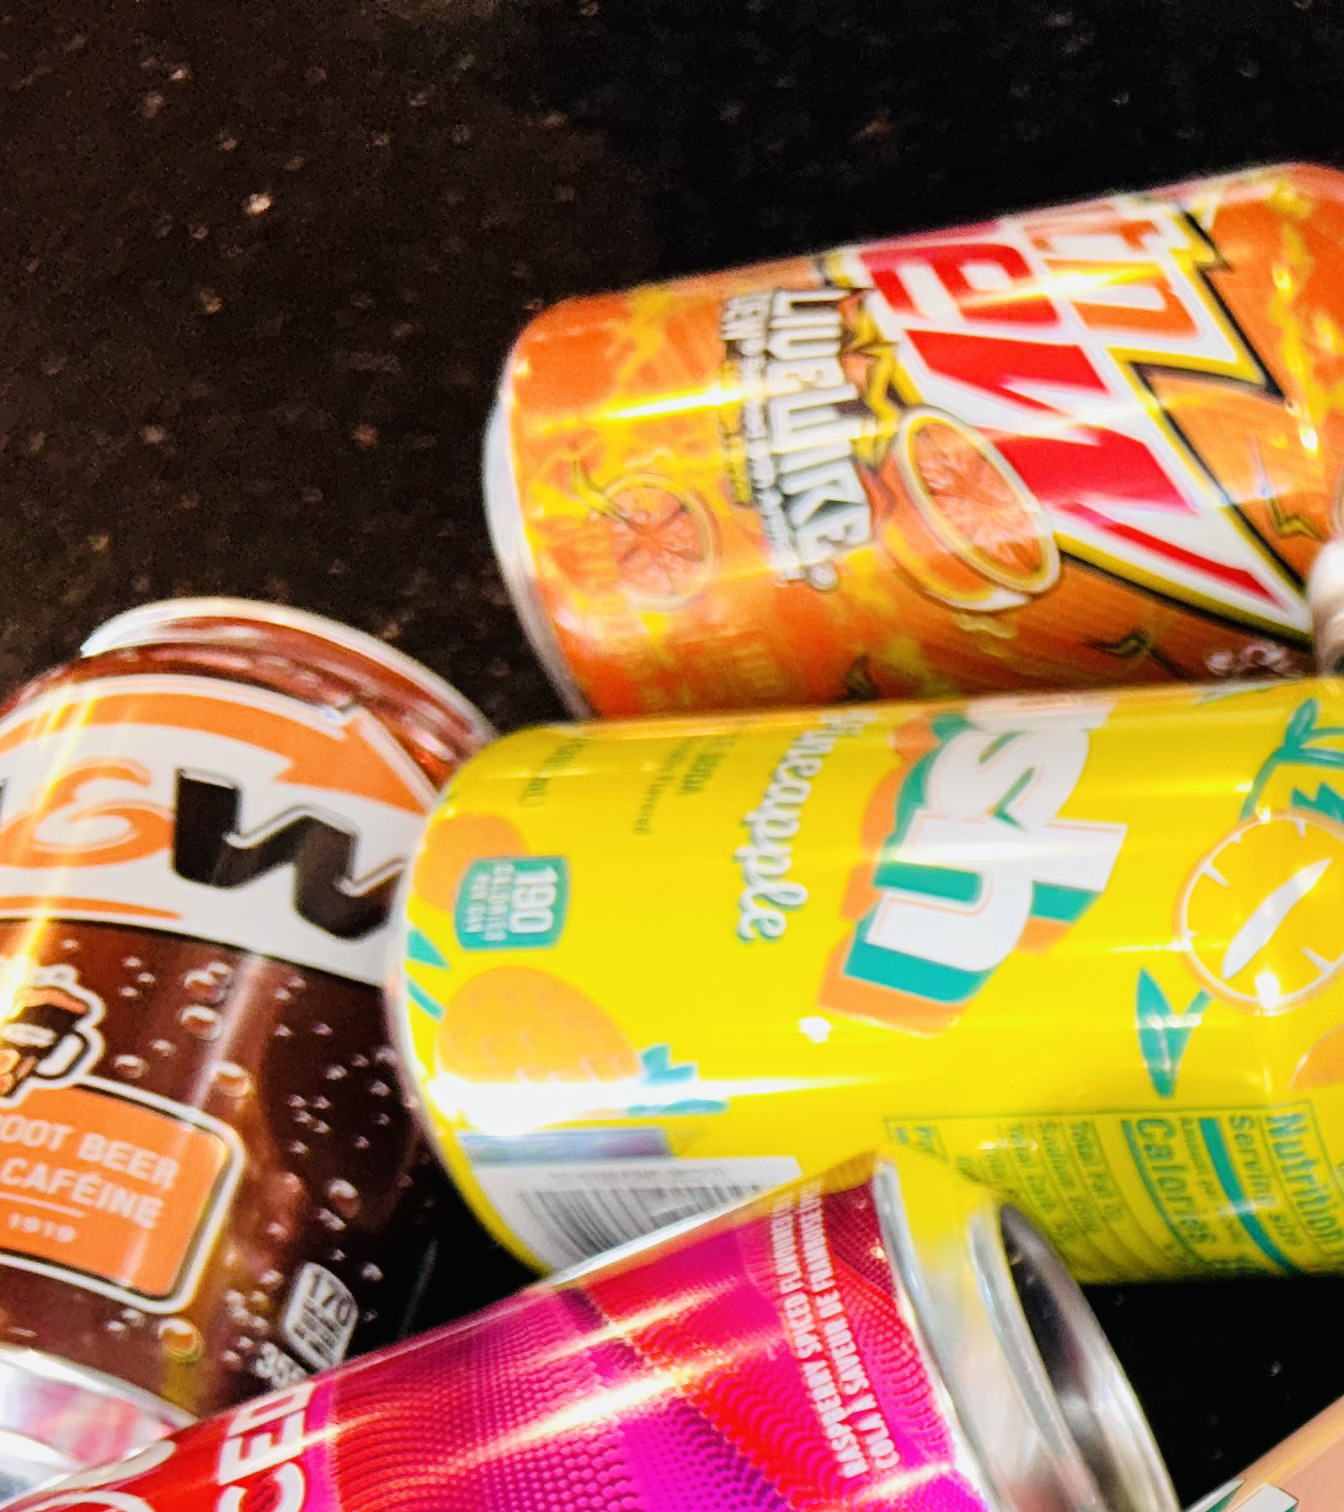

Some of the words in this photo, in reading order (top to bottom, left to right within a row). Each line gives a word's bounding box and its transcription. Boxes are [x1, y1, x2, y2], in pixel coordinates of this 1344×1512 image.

[508, 865, 559, 936] 190
[0, 1114, 76, 1152] OOT
[78, 1132, 178, 1192] BEER
[784, 1292, 823, 1360] SPICED
[815, 1287, 845, 1320] DE
[824, 1315, 871, 1397] SAVEUR
[802, 1357, 870, 1479] RASPBERRY
[857, 1411, 901, 1471] COLA
